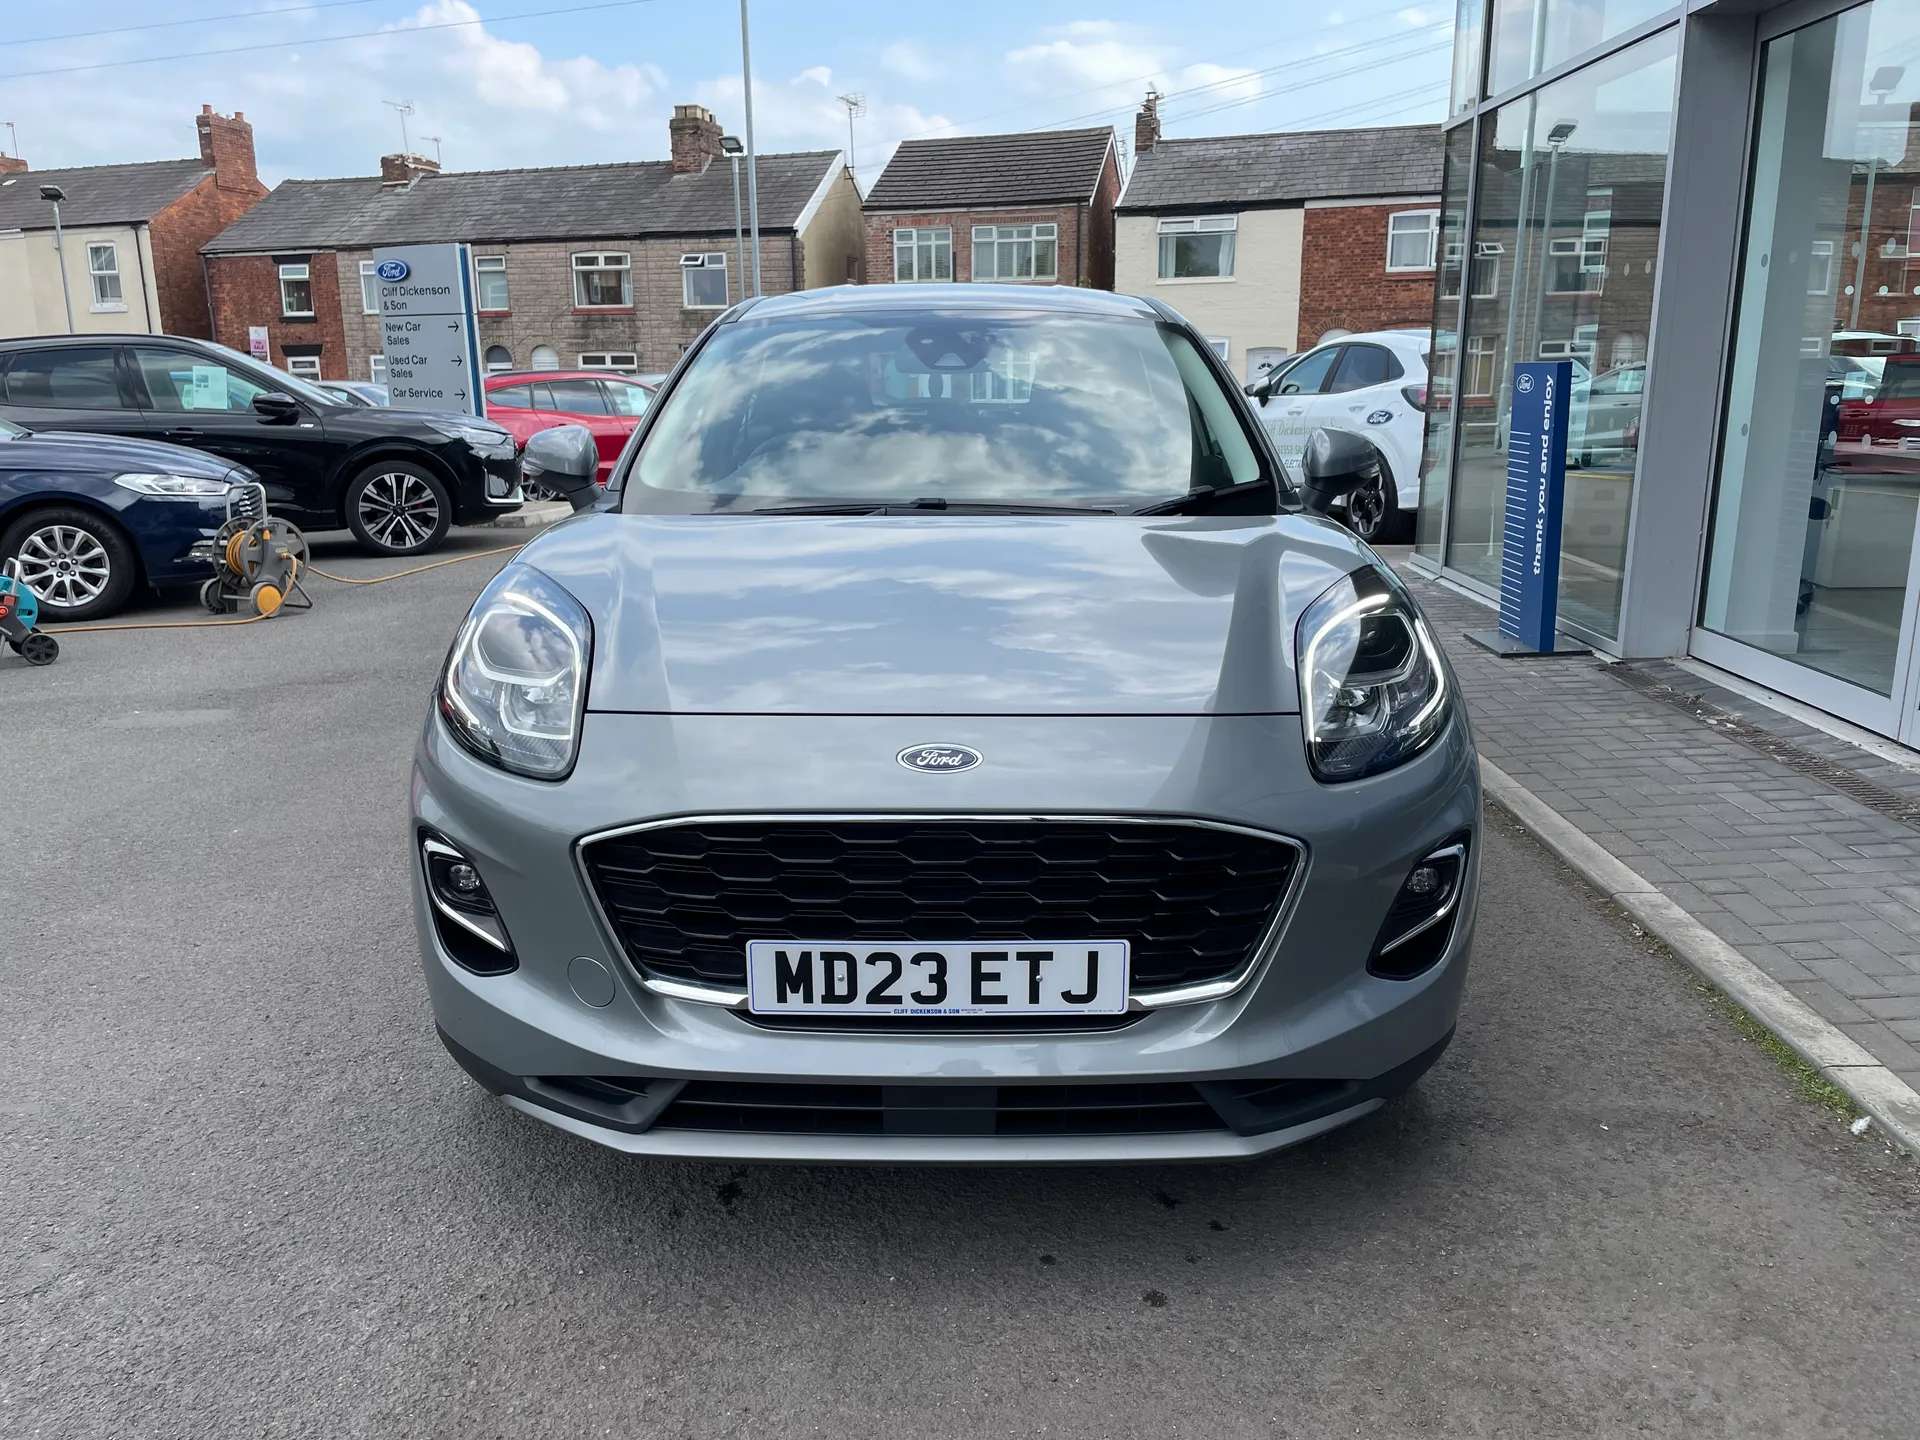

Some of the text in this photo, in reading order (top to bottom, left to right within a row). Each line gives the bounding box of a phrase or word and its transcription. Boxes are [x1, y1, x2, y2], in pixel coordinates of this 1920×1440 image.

[382, 263, 401, 277] Ford
[382, 285, 450, 297] Cliff Dickenson
[383, 300, 407, 310] & Son
[385, 321, 421, 332] New Car
[387, 336, 410, 345] Sales
[389, 355, 427, 365] Used Car
[391, 369, 413, 378] Sales
[392, 388, 443, 398] Car Service
[1369, 411, 1389, 424] Ford
[1533, 374, 1554, 575] thank you and enjoy
[916, 749, 963, 766] Ford
[774, 950, 1099, 1005] MD23 ETJ
